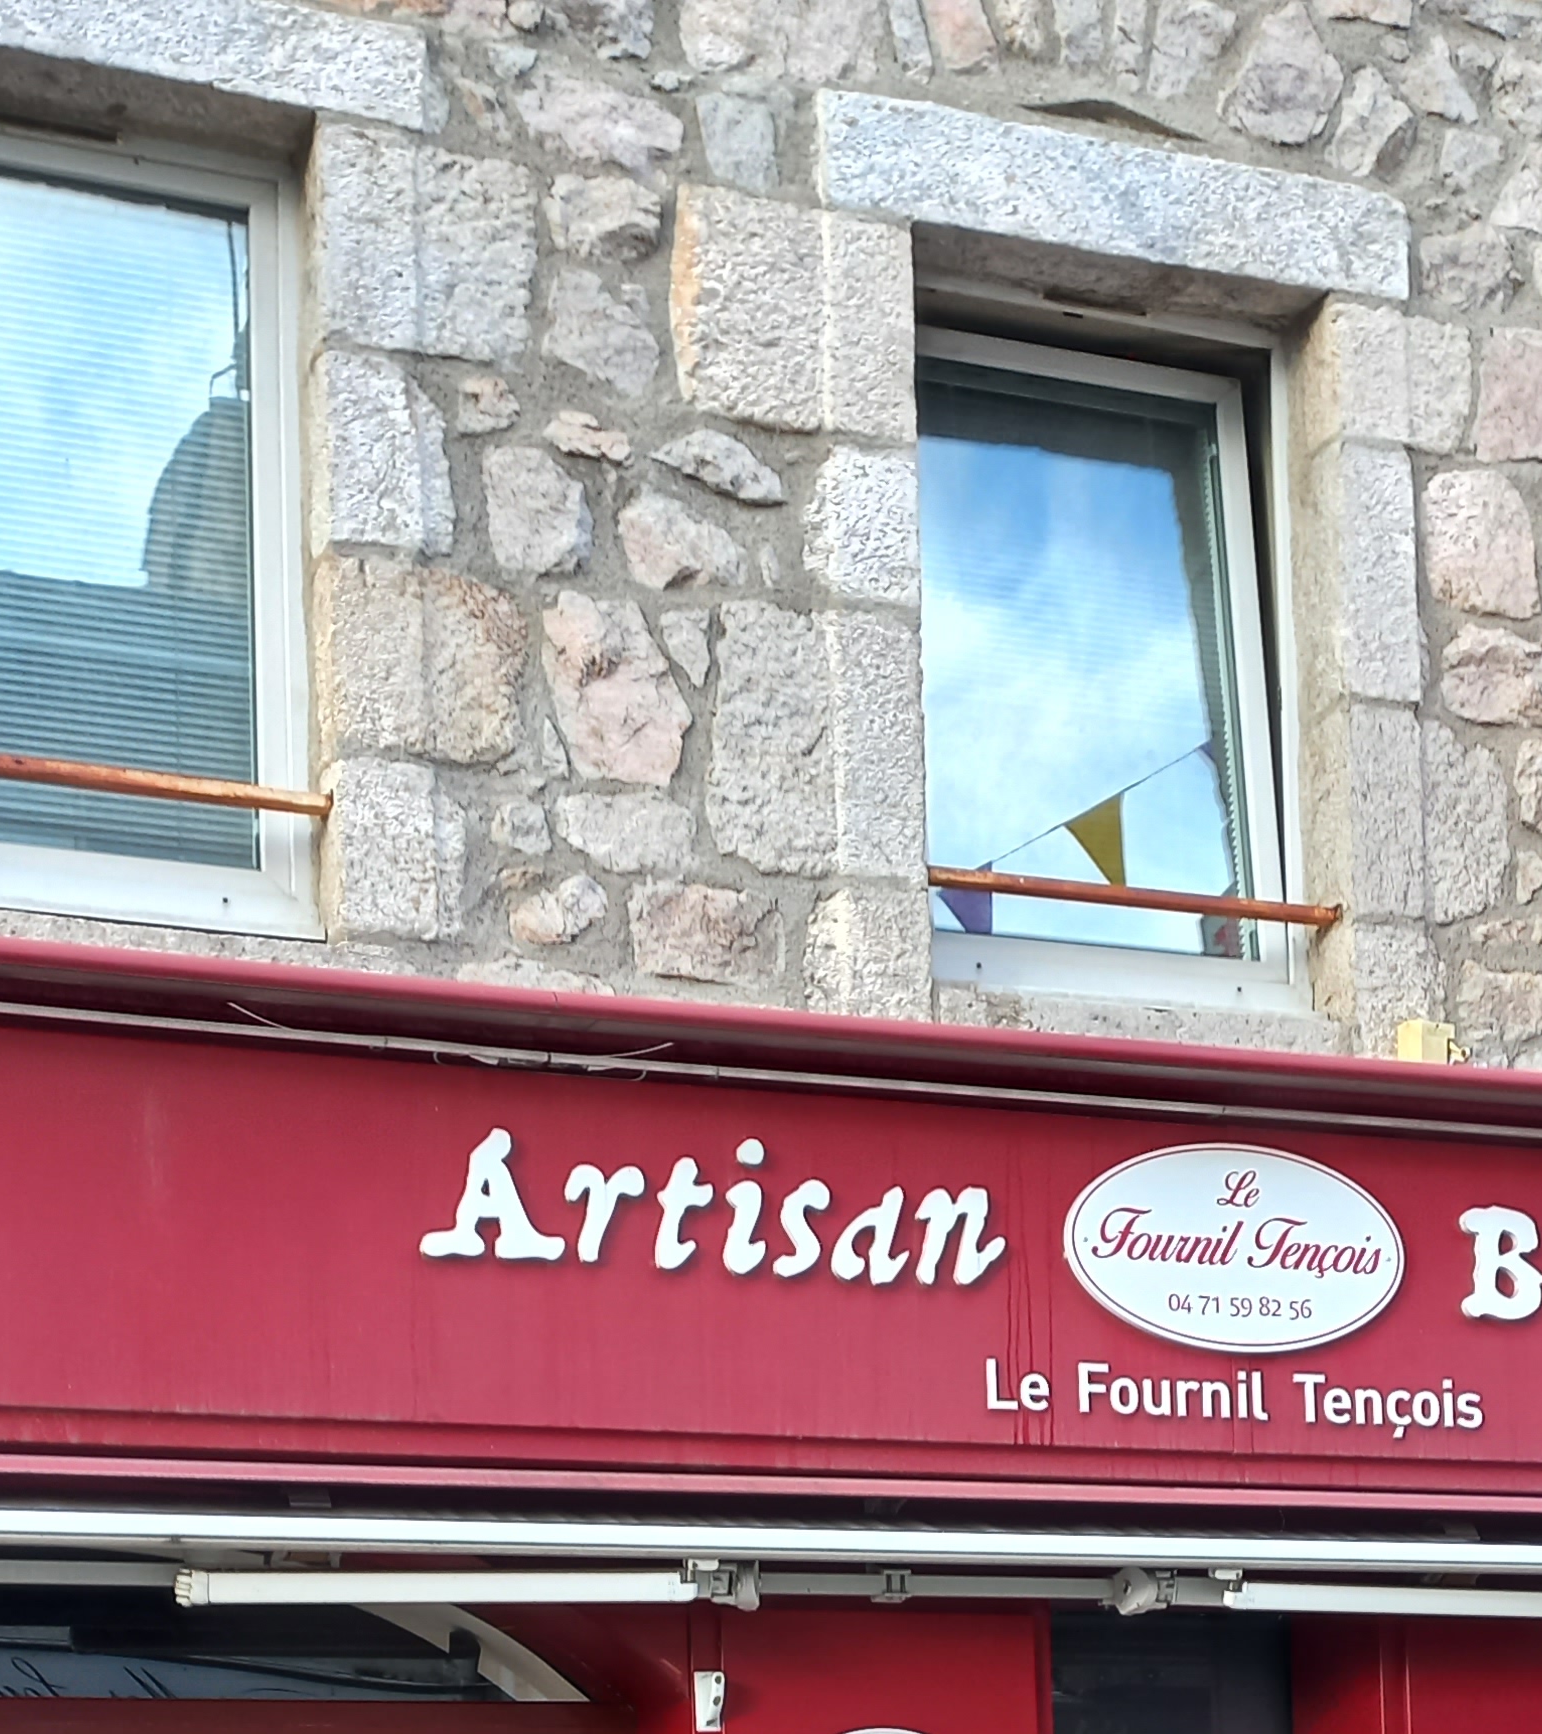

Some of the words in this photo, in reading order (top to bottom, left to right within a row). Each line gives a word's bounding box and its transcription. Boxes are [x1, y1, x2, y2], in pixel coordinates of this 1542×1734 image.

[418, 1127, 1006, 1286] Artisan
[1216, 1169, 1261, 1208] Le
[1091, 1206, 1244, 1267] Fournil
[1246, 1216, 1382, 1279] Tençois
[1167, 1293, 1194, 1314] 04
[1198, 1295, 1220, 1315] 71
[1229, 1297, 1253, 1318] 59
[1258, 1298, 1283, 1318] 82
[1288, 1299, 1313, 1320] 56
[985, 1357, 1050, 1411] Le
[1078, 1361, 1269, 1421] Fournil
[1293, 1373, 1483, 1439] Tençois
